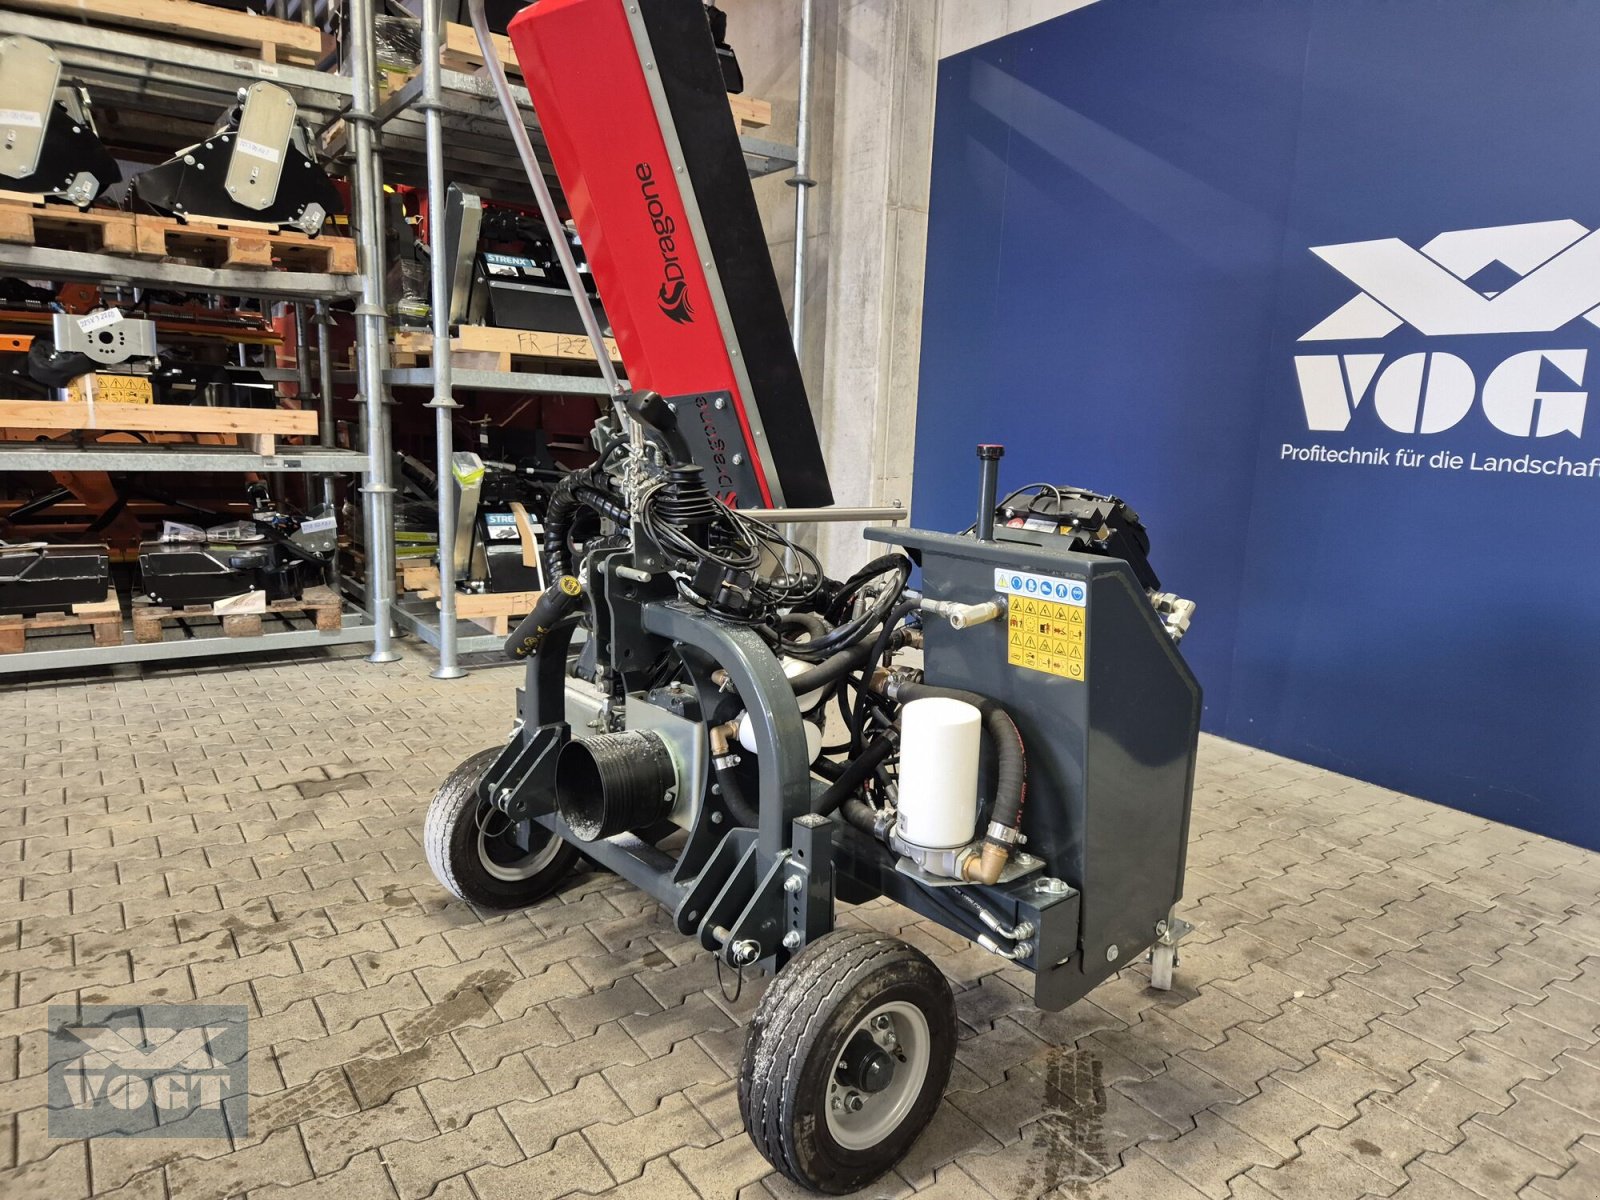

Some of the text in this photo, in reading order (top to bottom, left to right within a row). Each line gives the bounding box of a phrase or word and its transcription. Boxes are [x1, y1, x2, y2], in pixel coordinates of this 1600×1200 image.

[635, 162, 685, 282] Dragone
[488, 254, 526, 266] STRENX
[1293, 348, 1589, 439] VOG
[1280, 443, 1600, 478] Profitechnik für die Landschaf
[489, 515, 517, 523] STRE
